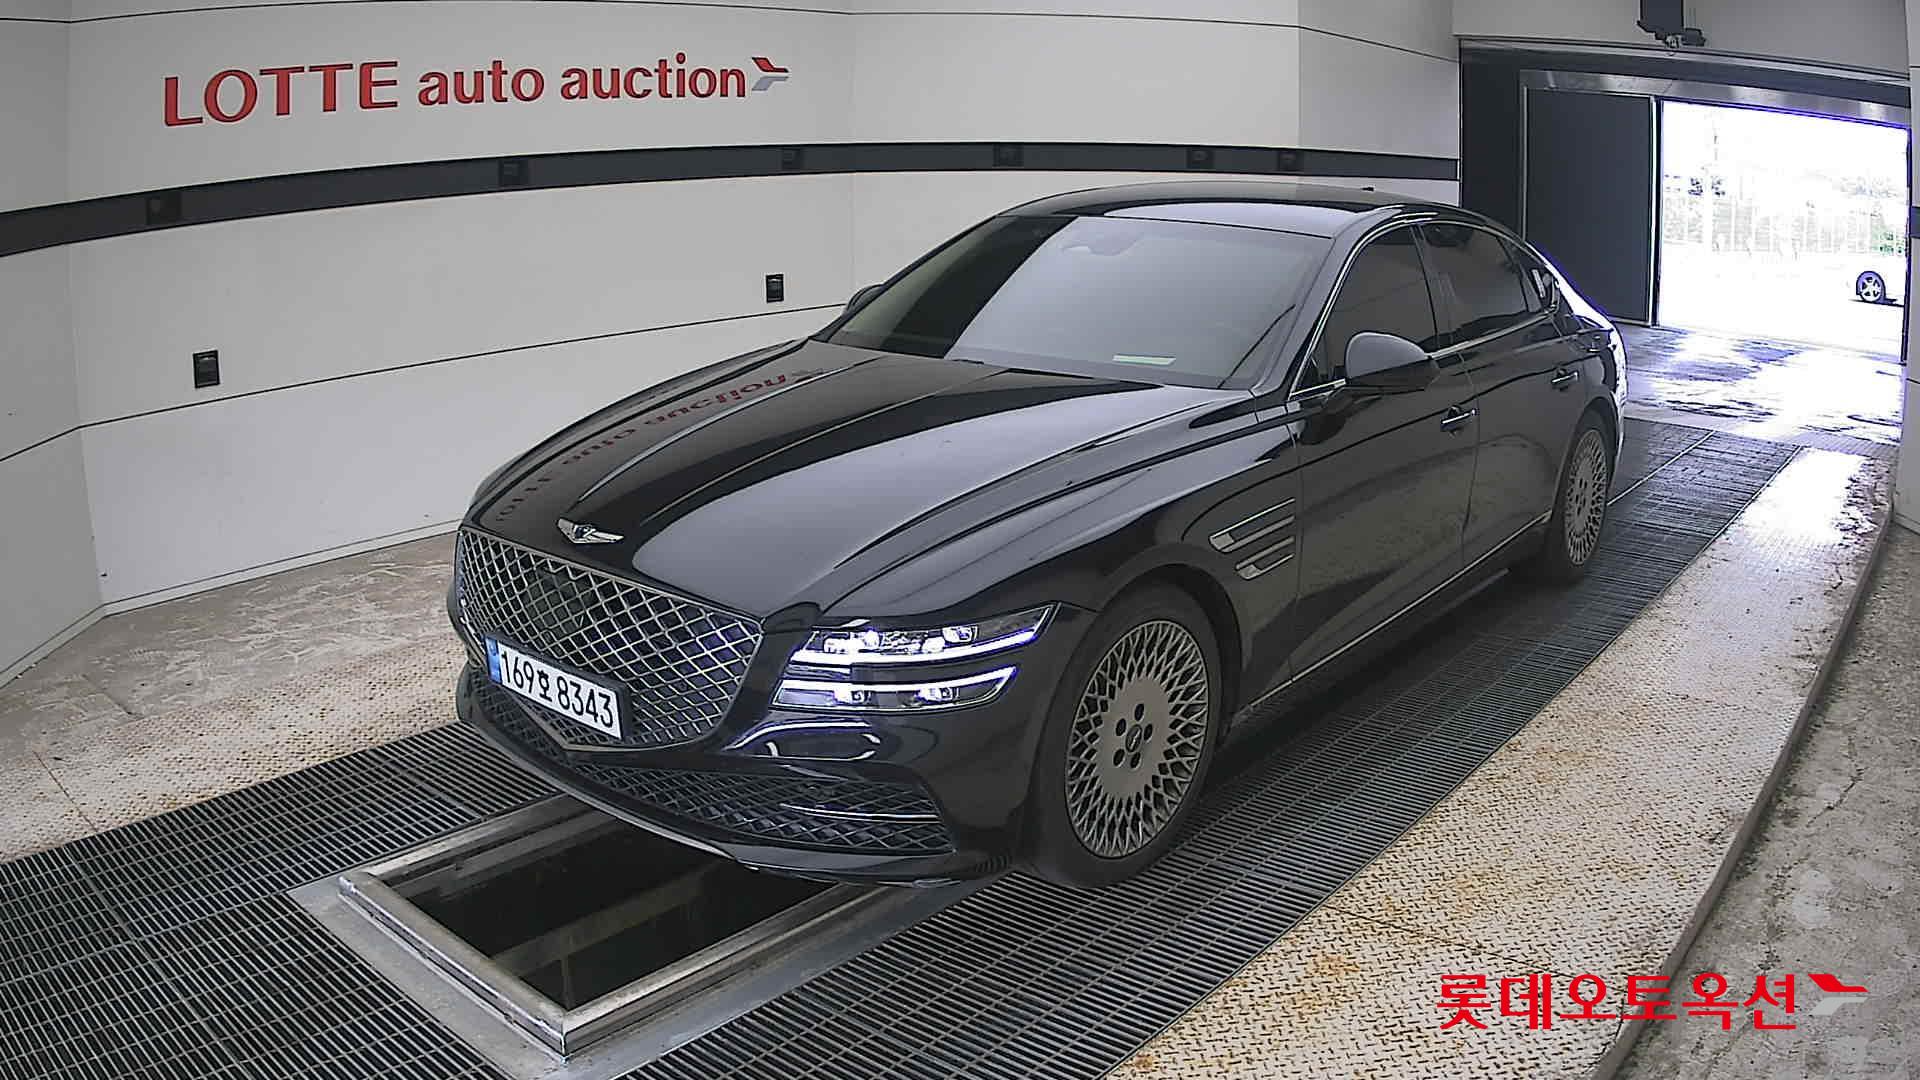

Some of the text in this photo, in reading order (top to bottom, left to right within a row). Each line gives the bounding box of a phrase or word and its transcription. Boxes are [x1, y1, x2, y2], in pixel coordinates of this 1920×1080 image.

[164, 52, 747, 127] LOTTE auto auction
[501, 650, 614, 728] 169호 8343
